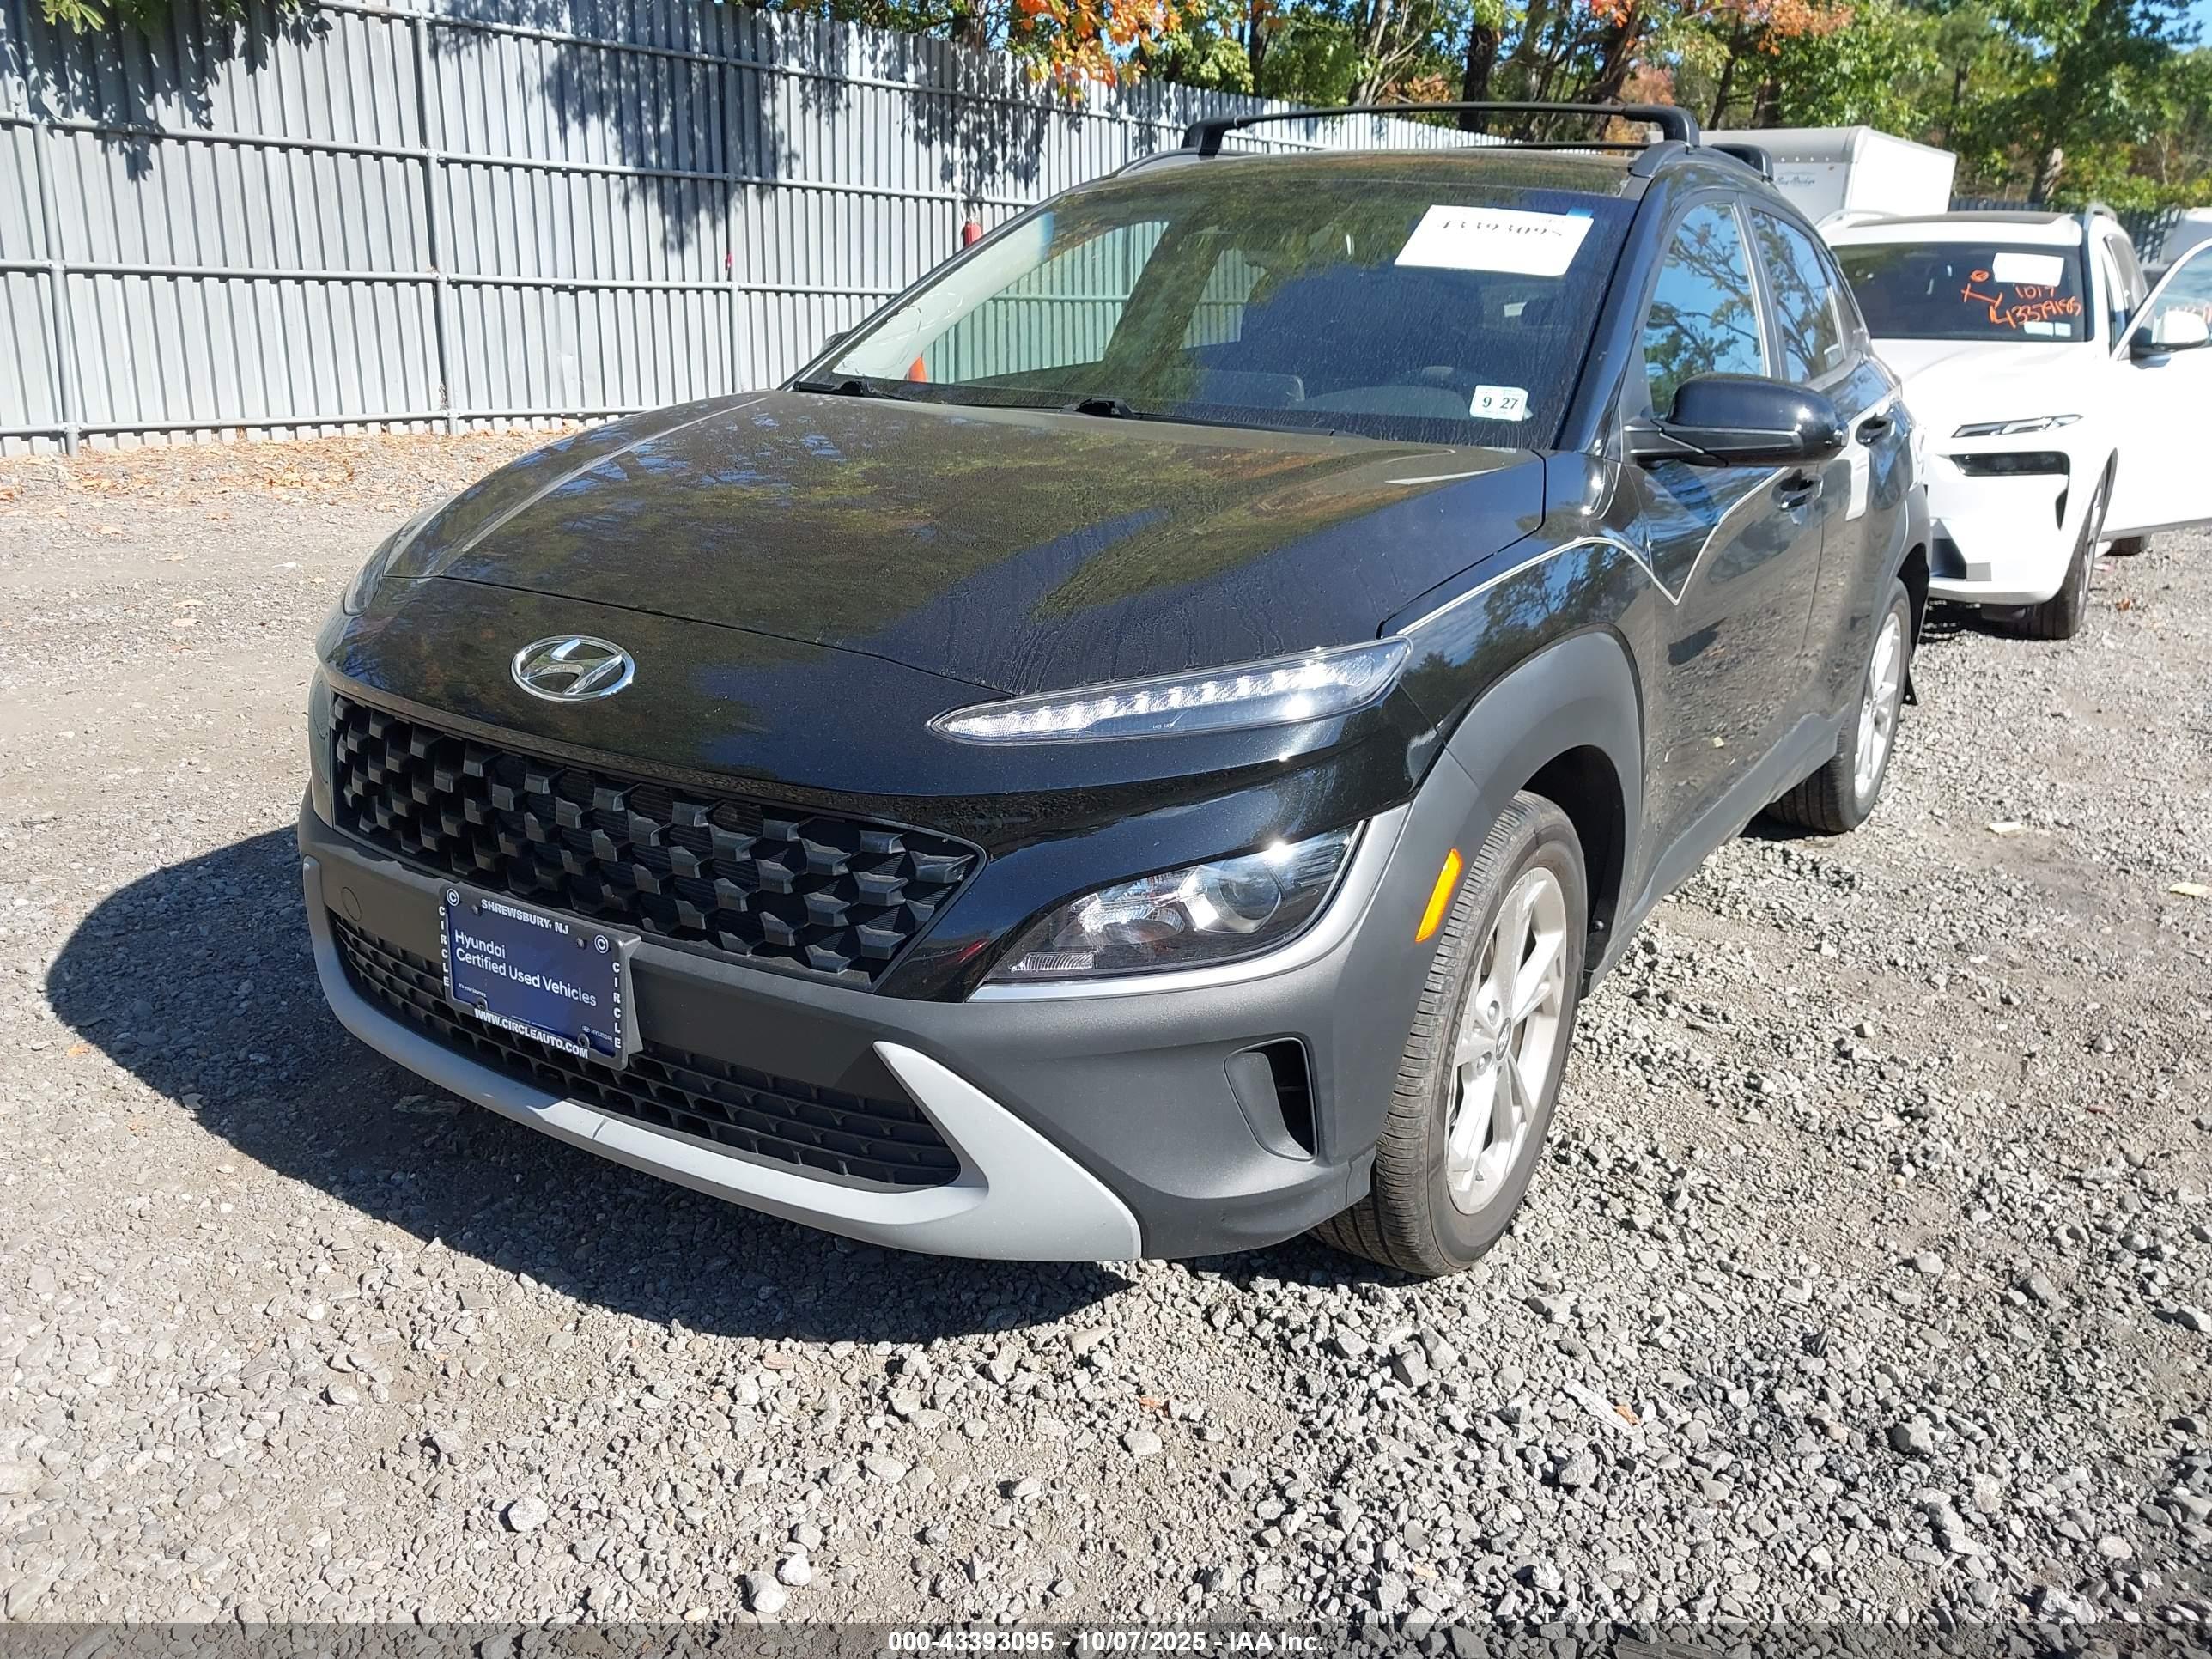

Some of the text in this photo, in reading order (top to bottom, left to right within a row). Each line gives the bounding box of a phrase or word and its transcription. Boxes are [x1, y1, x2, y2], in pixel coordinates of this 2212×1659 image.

[1482, 396, 1519, 410] 9 27
[481, 898, 569, 935] SHREWSBURY, NJ
[454, 929, 506, 959] Hyundai
[455, 948, 597, 1006] Certified Used Vehicles
[474, 1008, 589, 1060] WWW.CIRCLEAUTO.COM
